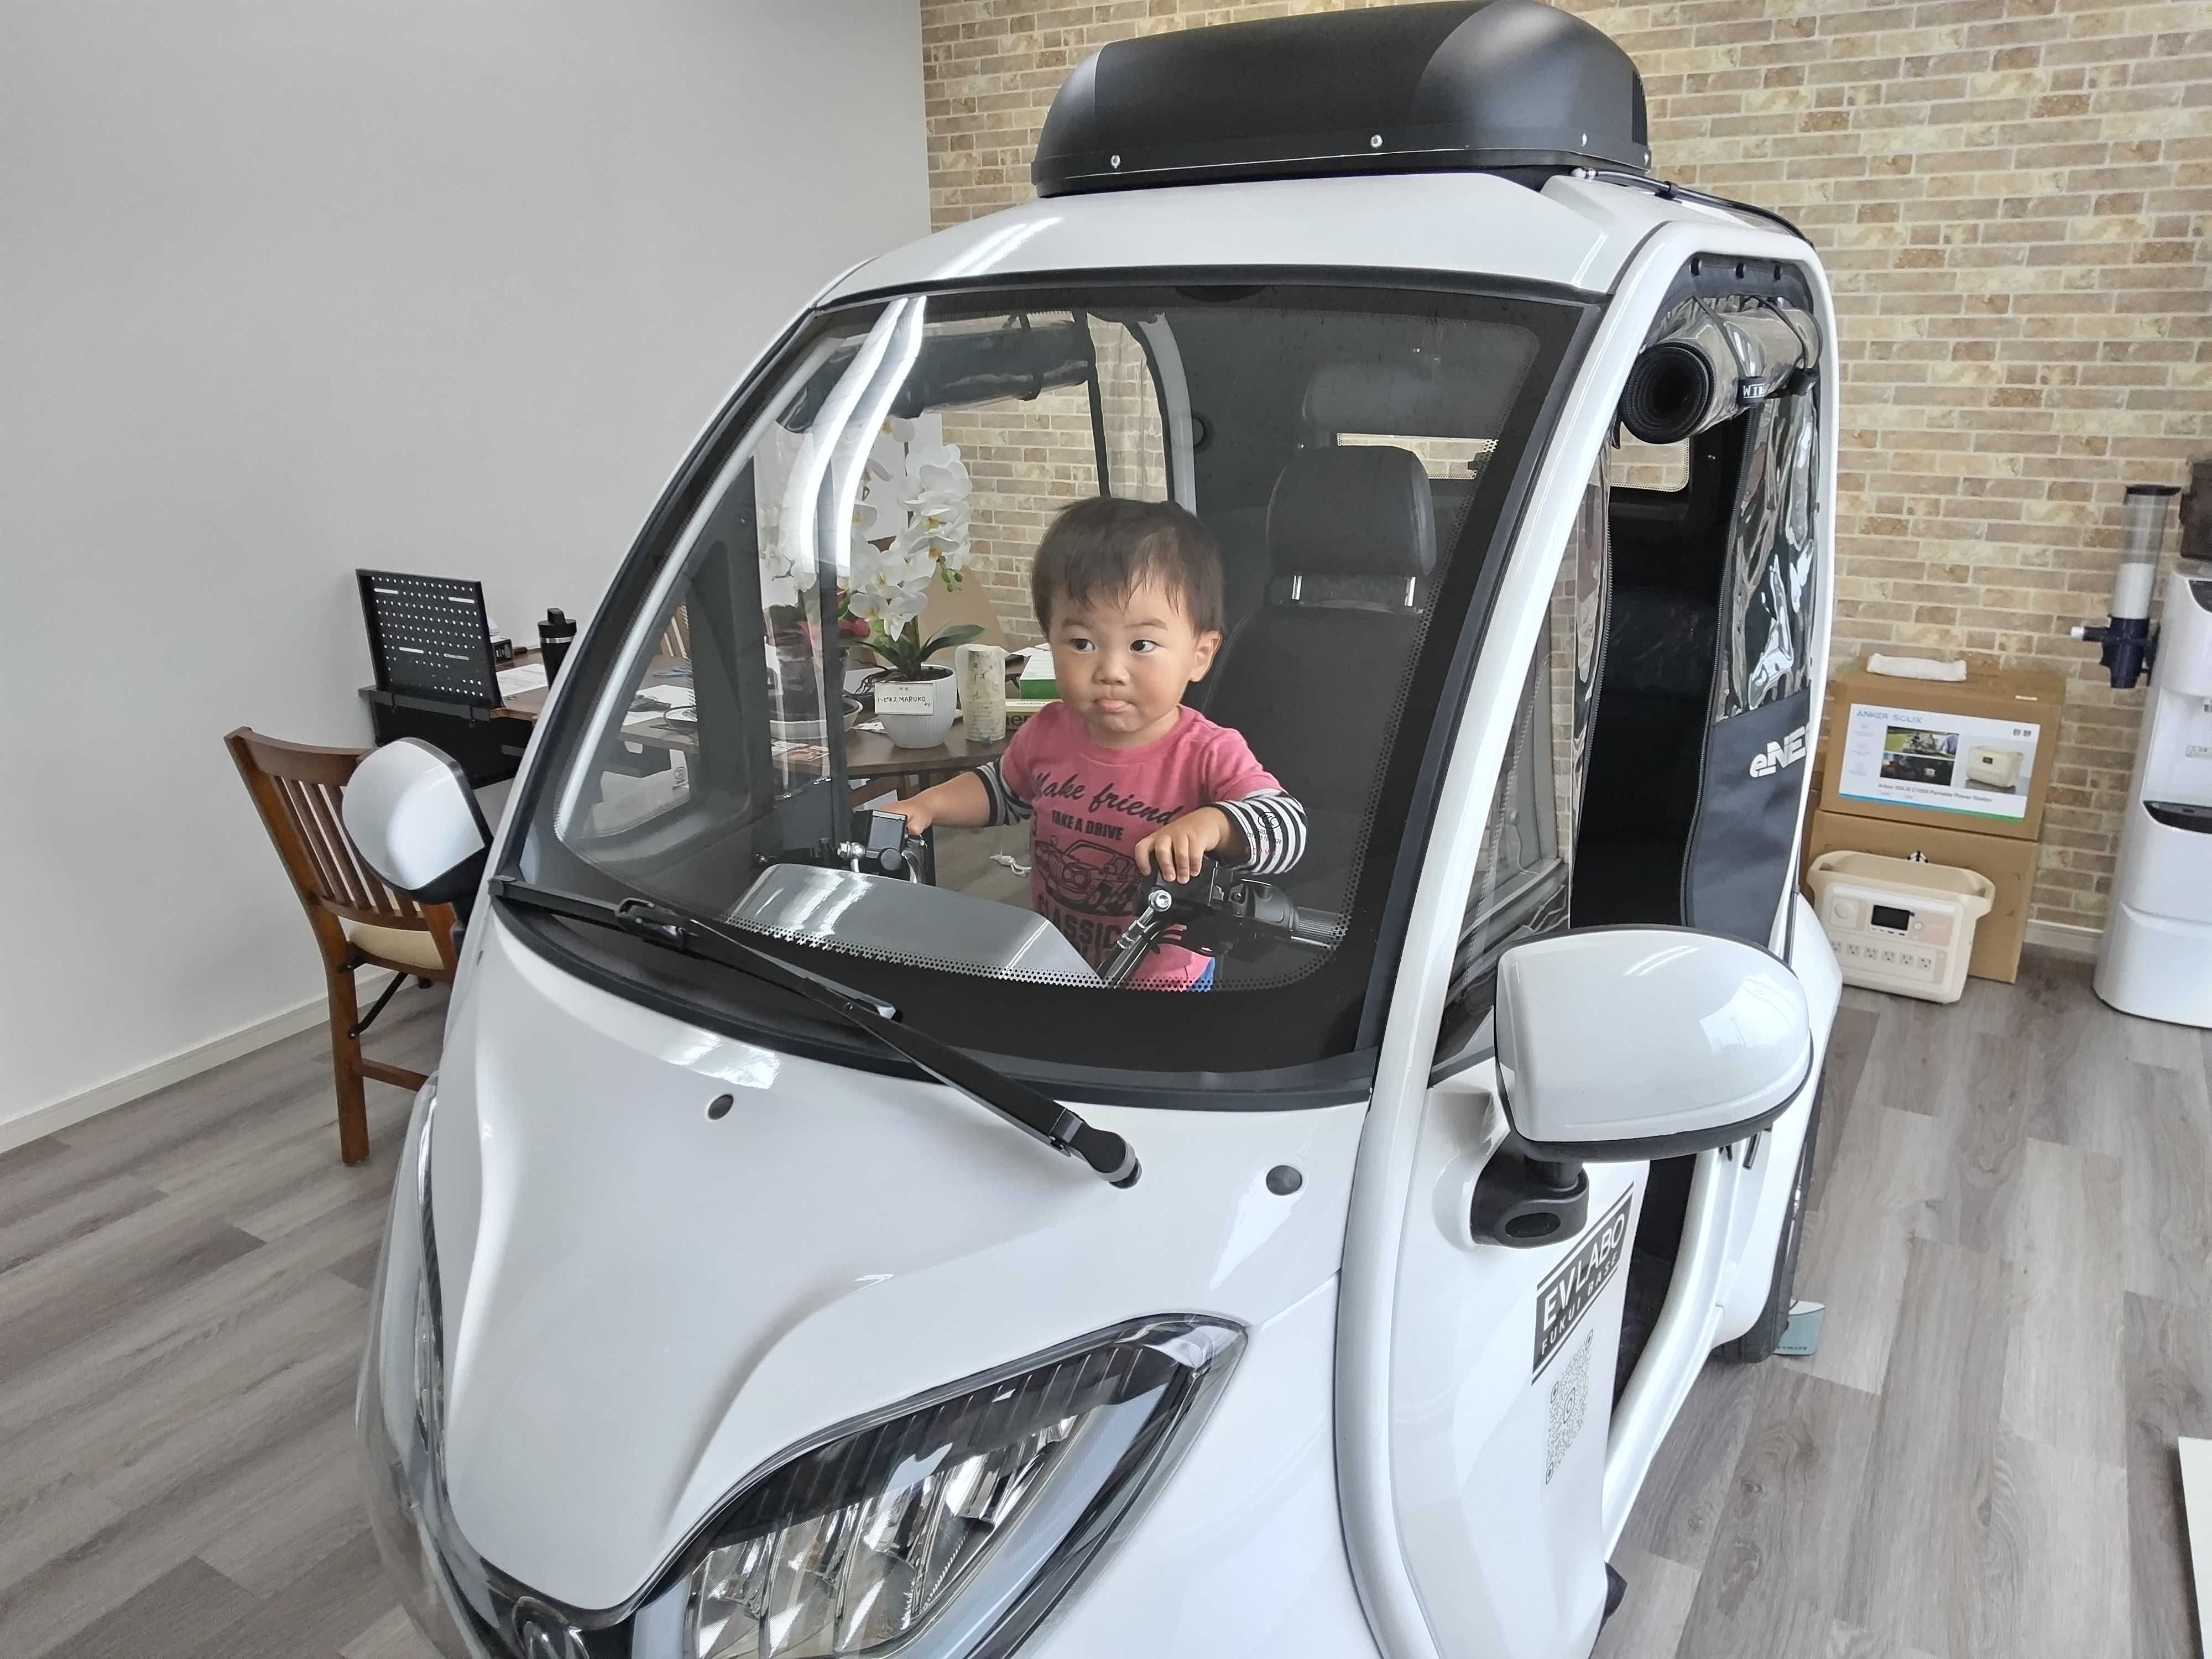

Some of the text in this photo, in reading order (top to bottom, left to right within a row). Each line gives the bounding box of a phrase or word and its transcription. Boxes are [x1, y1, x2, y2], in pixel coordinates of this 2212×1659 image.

[1052, 810, 1124, 841] TAKE A DRIVE
[1541, 1251, 1618, 1355] FUKUI BASE
